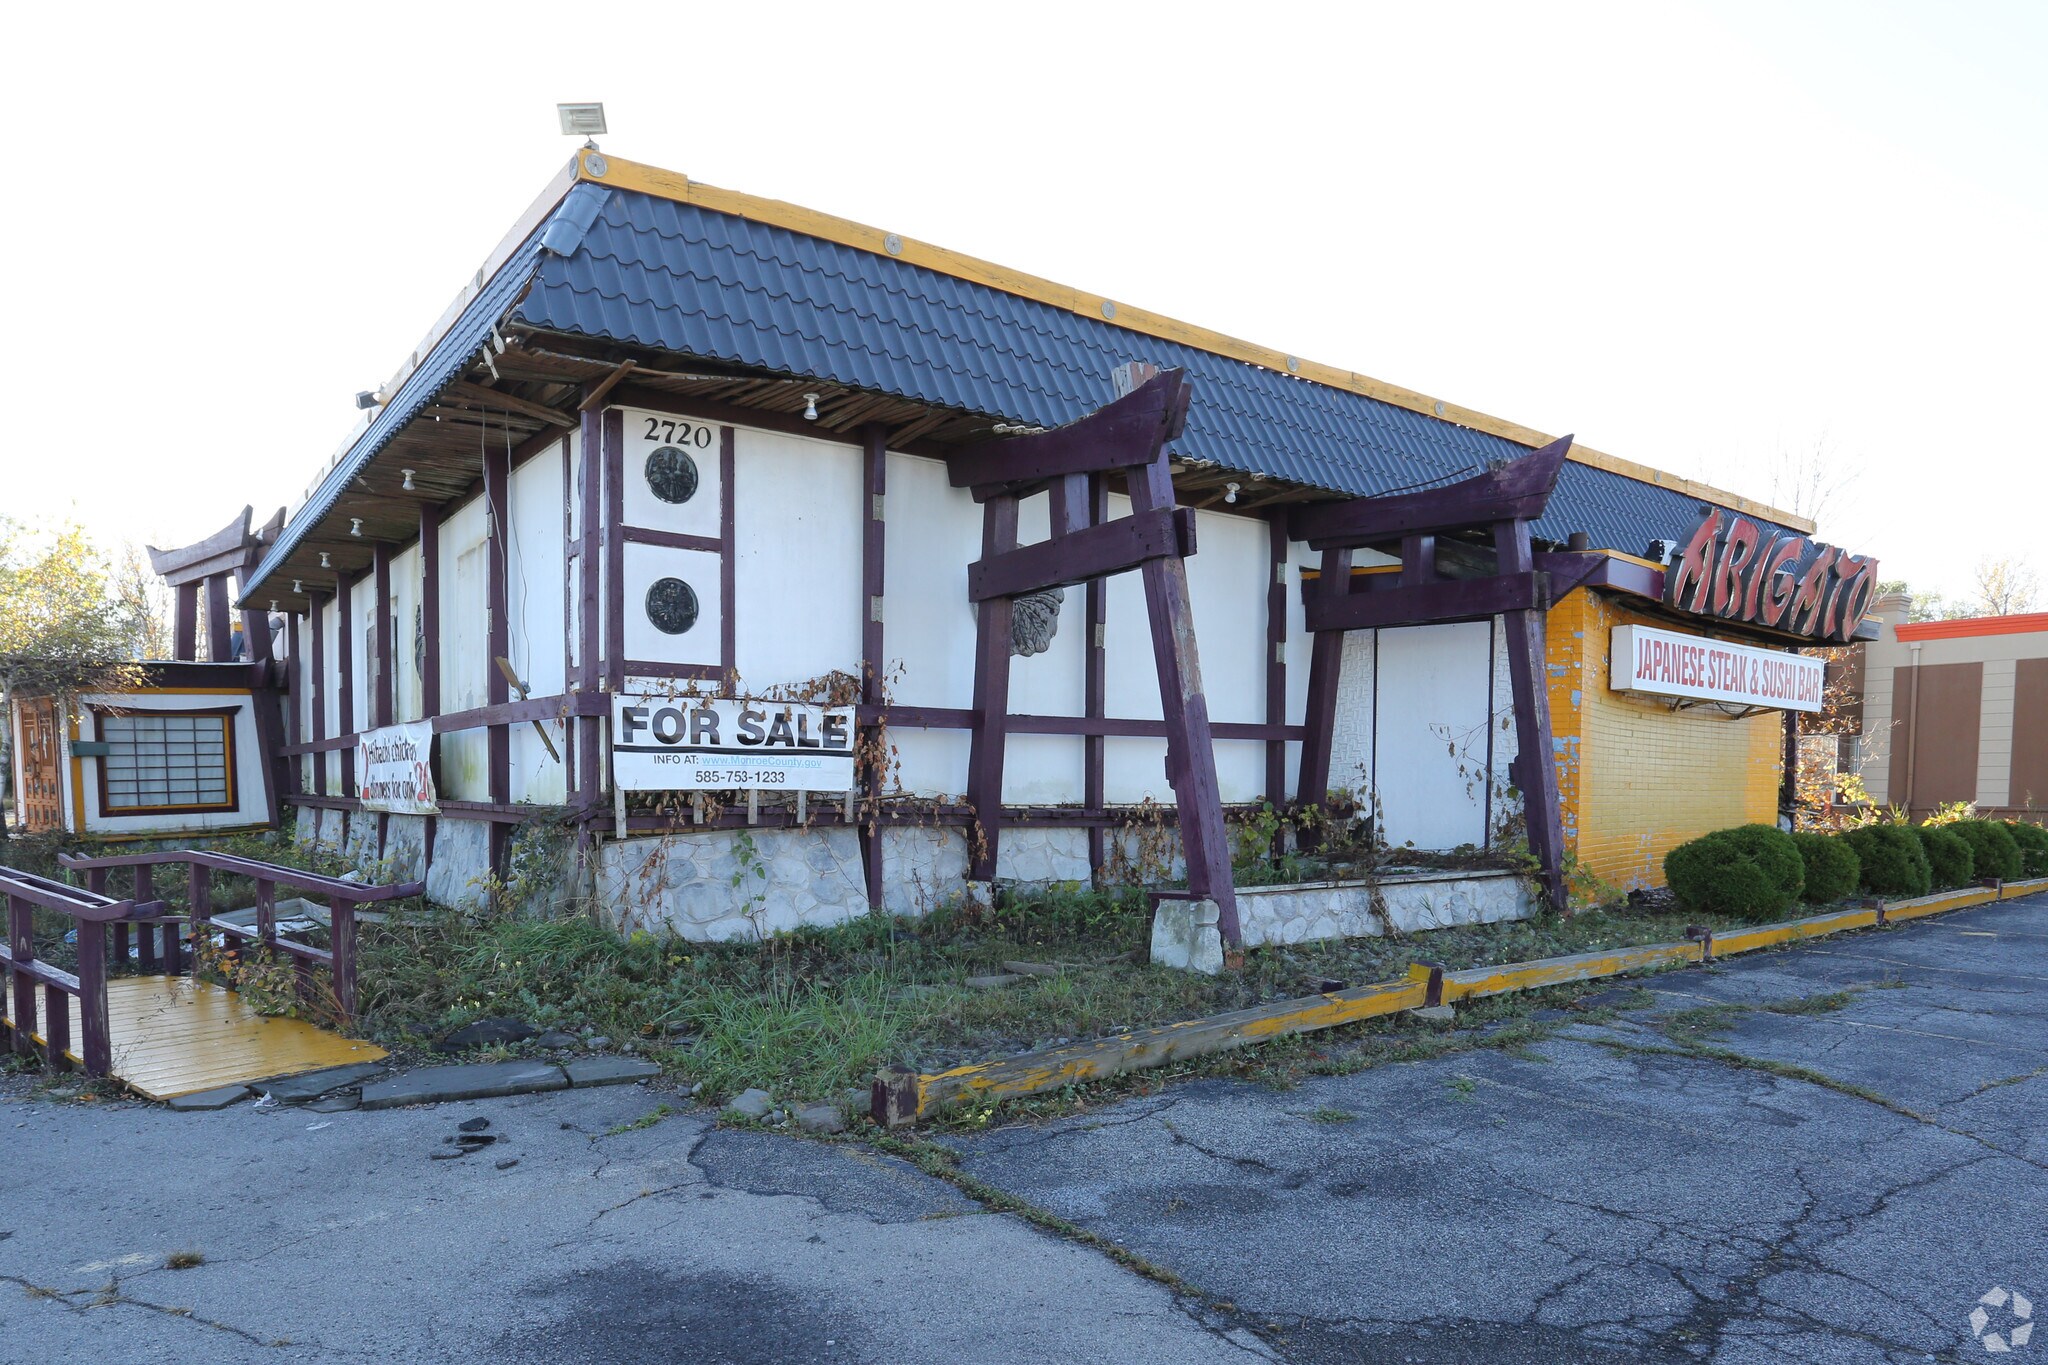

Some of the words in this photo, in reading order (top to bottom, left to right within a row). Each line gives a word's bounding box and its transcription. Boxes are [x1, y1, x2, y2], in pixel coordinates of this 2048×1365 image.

[644, 417, 712, 449] 2720
[1673, 506, 1880, 642] ARIGATO
[1636, 637, 1705, 688] JAPANESE
[1707, 649, 1747, 693] STEAK
[1750, 661, 1759, 695] &
[1762, 660, 1797, 700] SUSHI
[1798, 664, 1820, 703] BAR
[622, 706, 720, 745] FOR
[736, 710, 848, 749] SALE
[653, 754, 681, 765] INFO
[683, 754, 699, 765] AT:
[702, 755, 823, 769] www.MonroeCounty.gov
[695, 770, 785, 784] 585-753-1233
